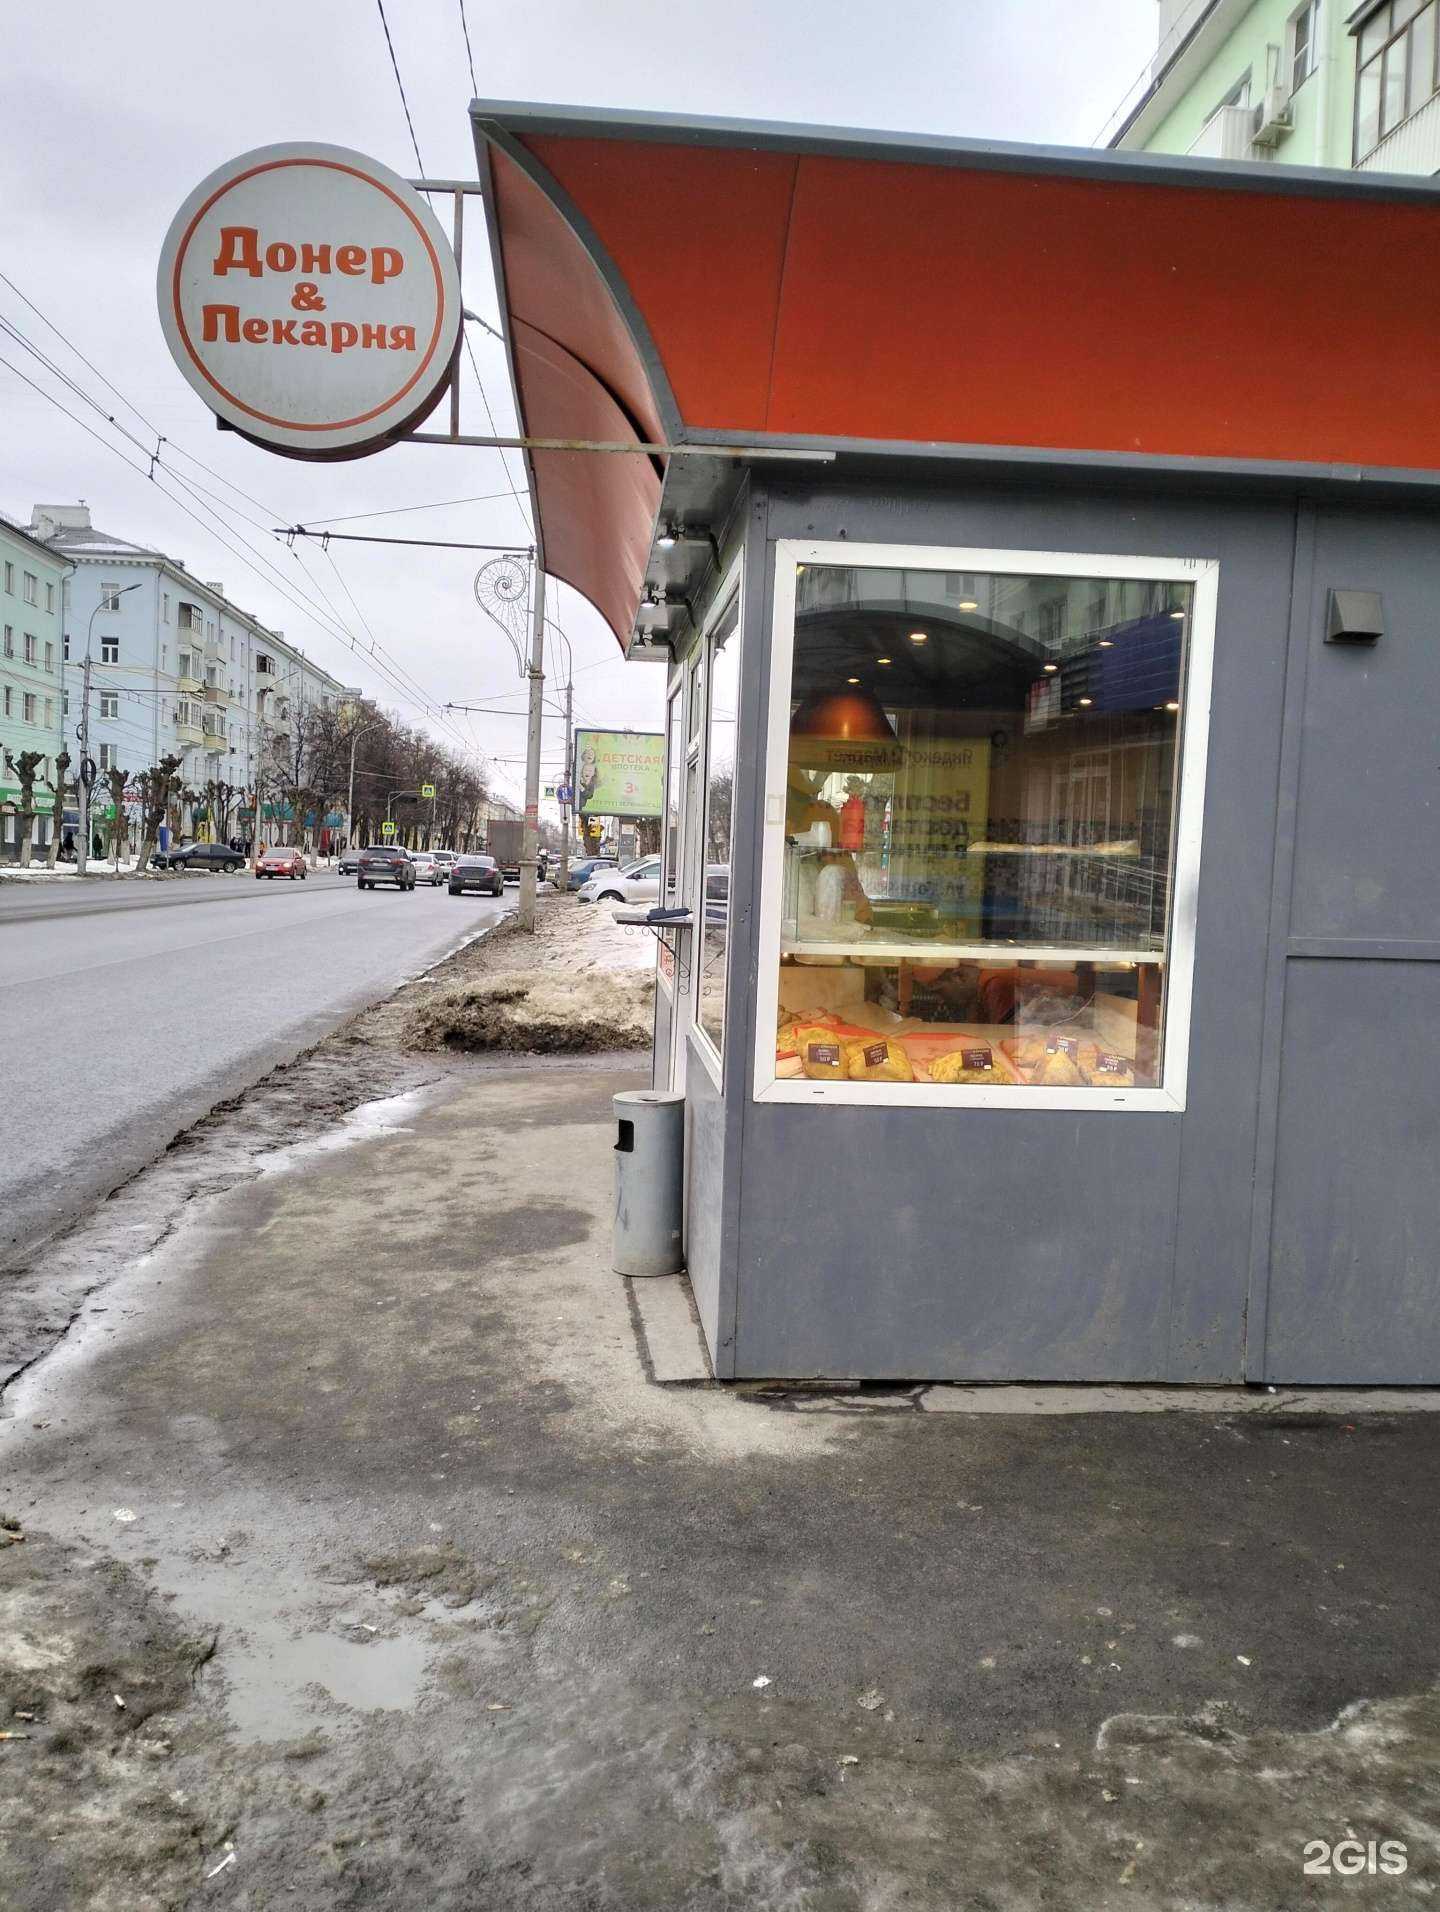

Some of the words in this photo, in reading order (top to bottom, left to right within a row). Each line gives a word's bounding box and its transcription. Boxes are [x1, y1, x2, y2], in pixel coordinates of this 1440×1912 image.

[213, 226, 404, 284] Донер
[291, 282, 327, 312] &
[202, 304, 416, 353] Пекарня
[603, 753, 660, 764] ДЕТСКАЯ
